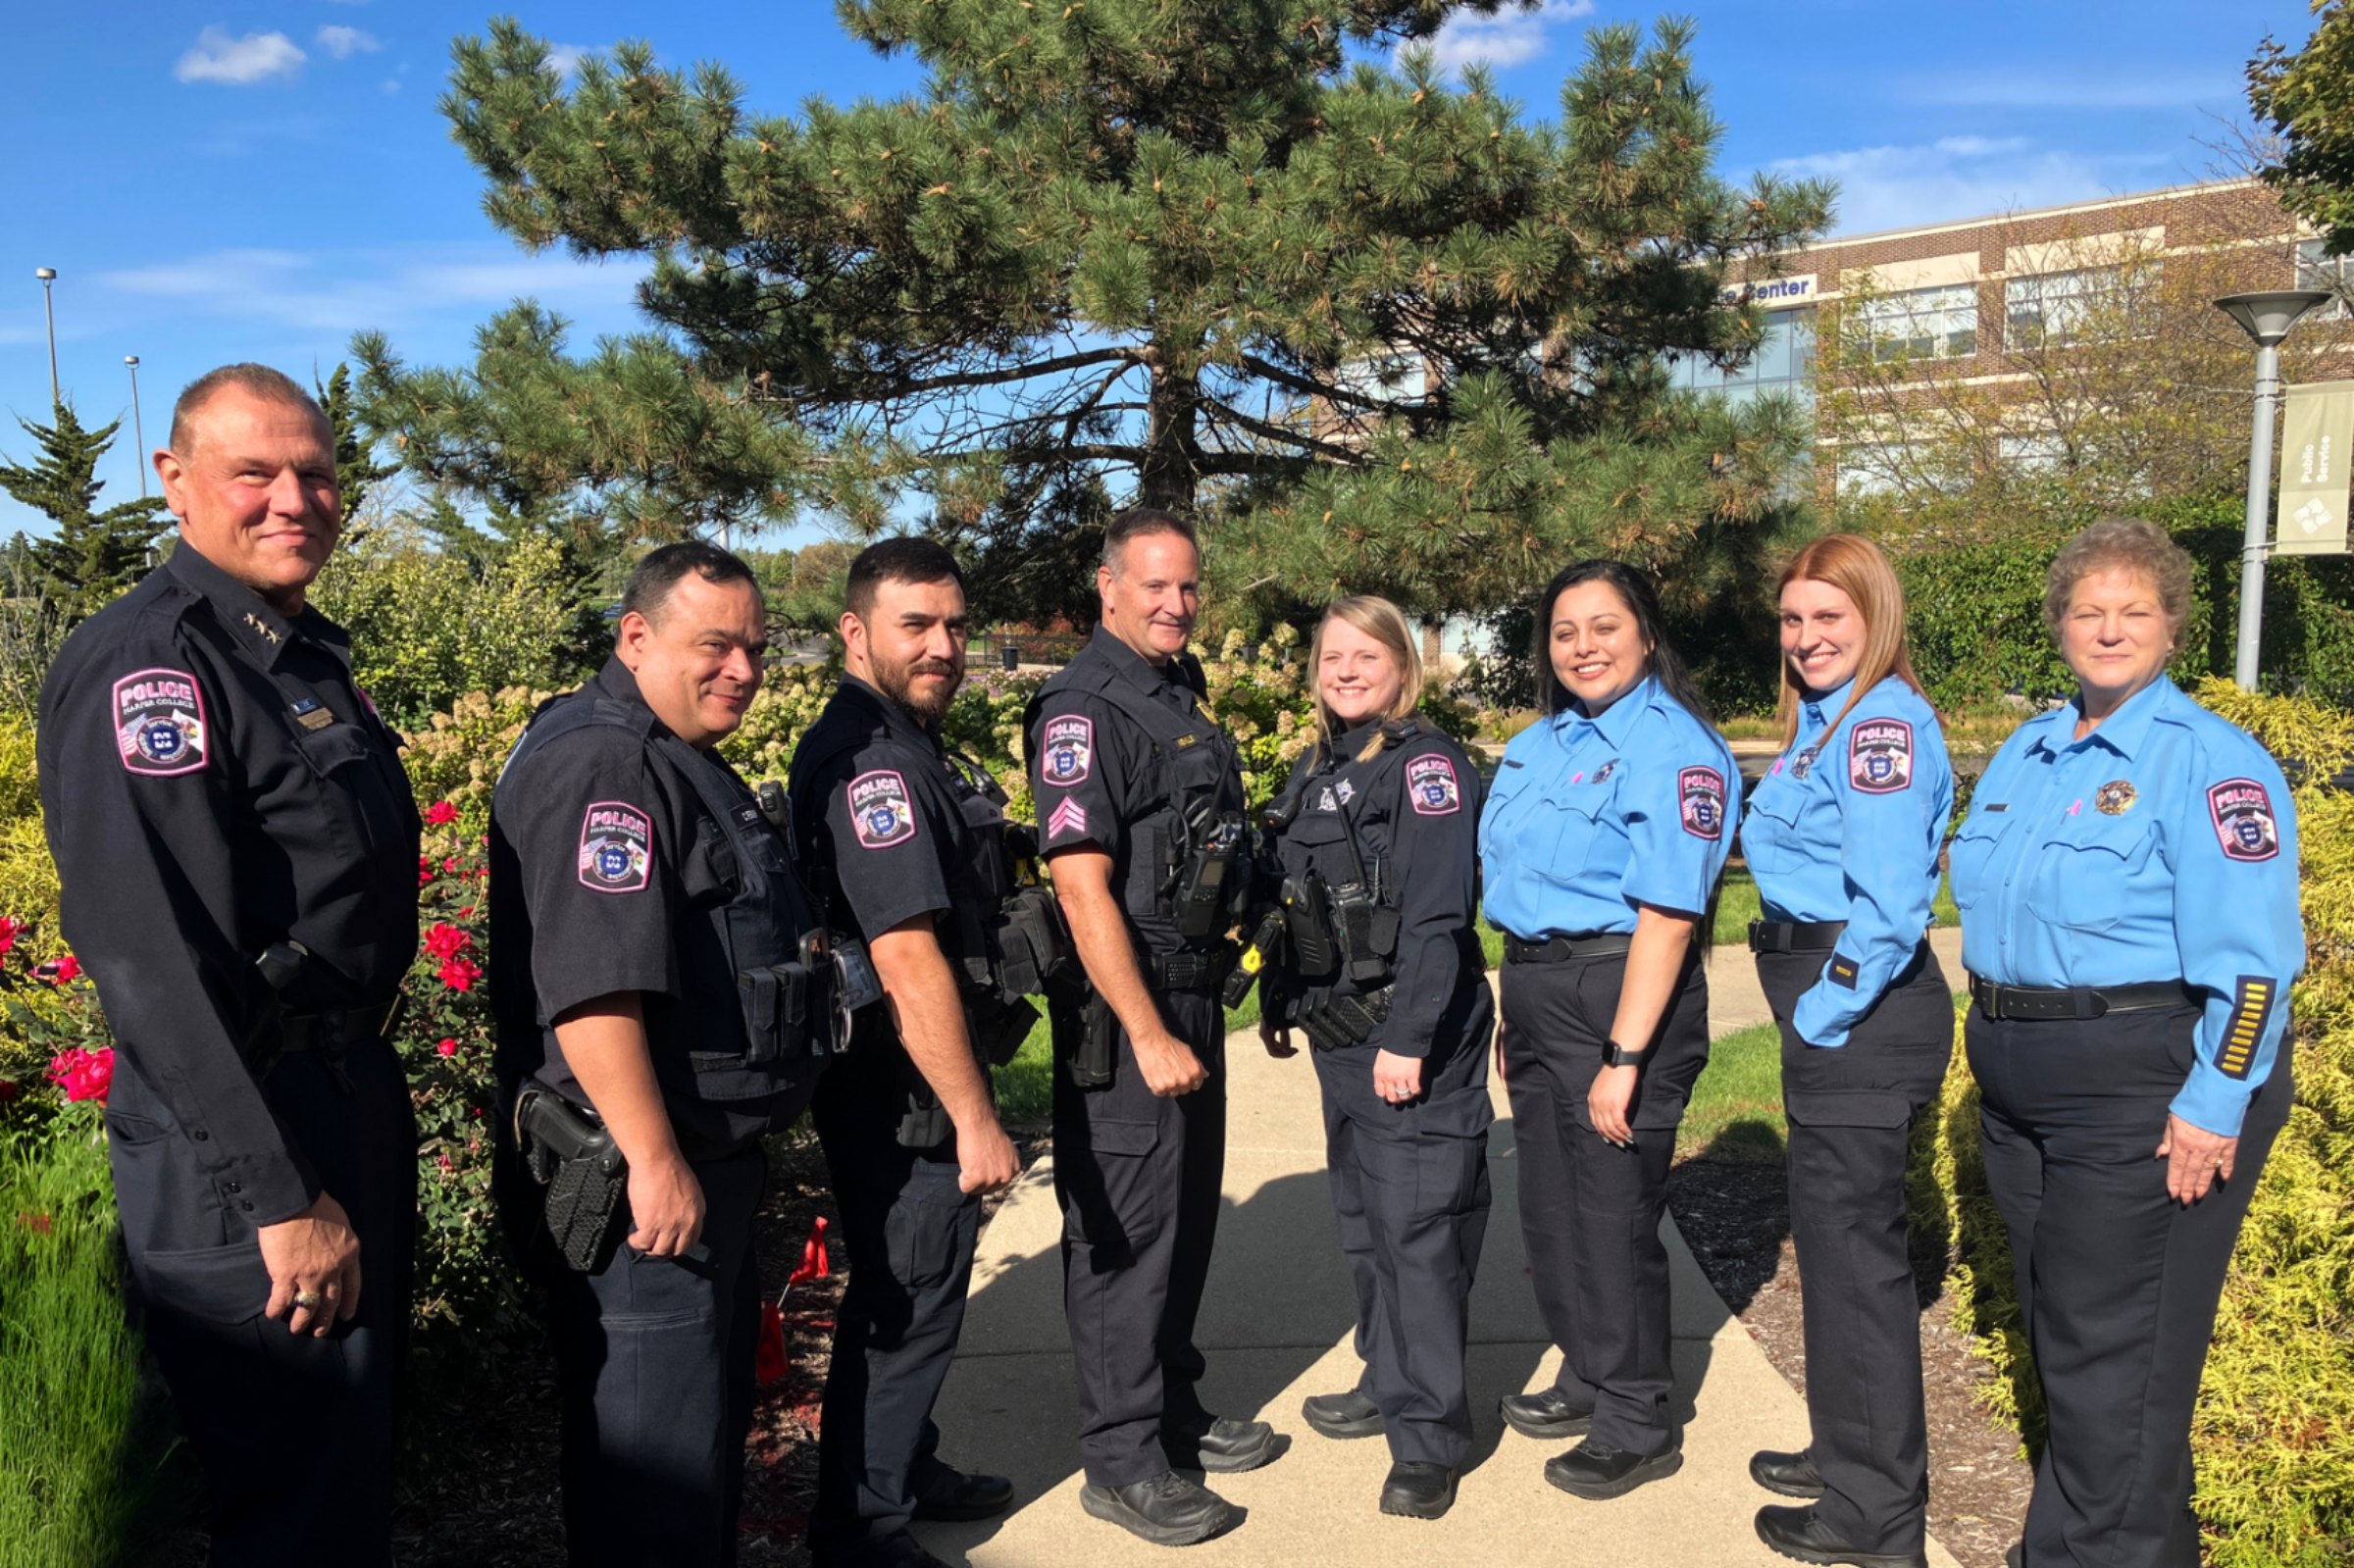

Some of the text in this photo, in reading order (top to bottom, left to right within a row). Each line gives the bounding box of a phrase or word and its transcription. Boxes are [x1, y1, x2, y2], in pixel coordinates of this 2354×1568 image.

[2300, 443, 2315, 483] Public
[2316, 434, 2330, 483] Service
[120, 681, 193, 707] POLICE
[156, 697, 195, 709] COLLEGE
[1049, 722, 1087, 739] POLICE
[1856, 727, 1906, 742] POLICE
[1410, 760, 1451, 776] POLICE
[851, 778, 900, 801] POLICE
[1683, 775, 1720, 792] POLICE
[2216, 787, 2265, 809] POLICE
[590, 810, 646, 835] POLICE
